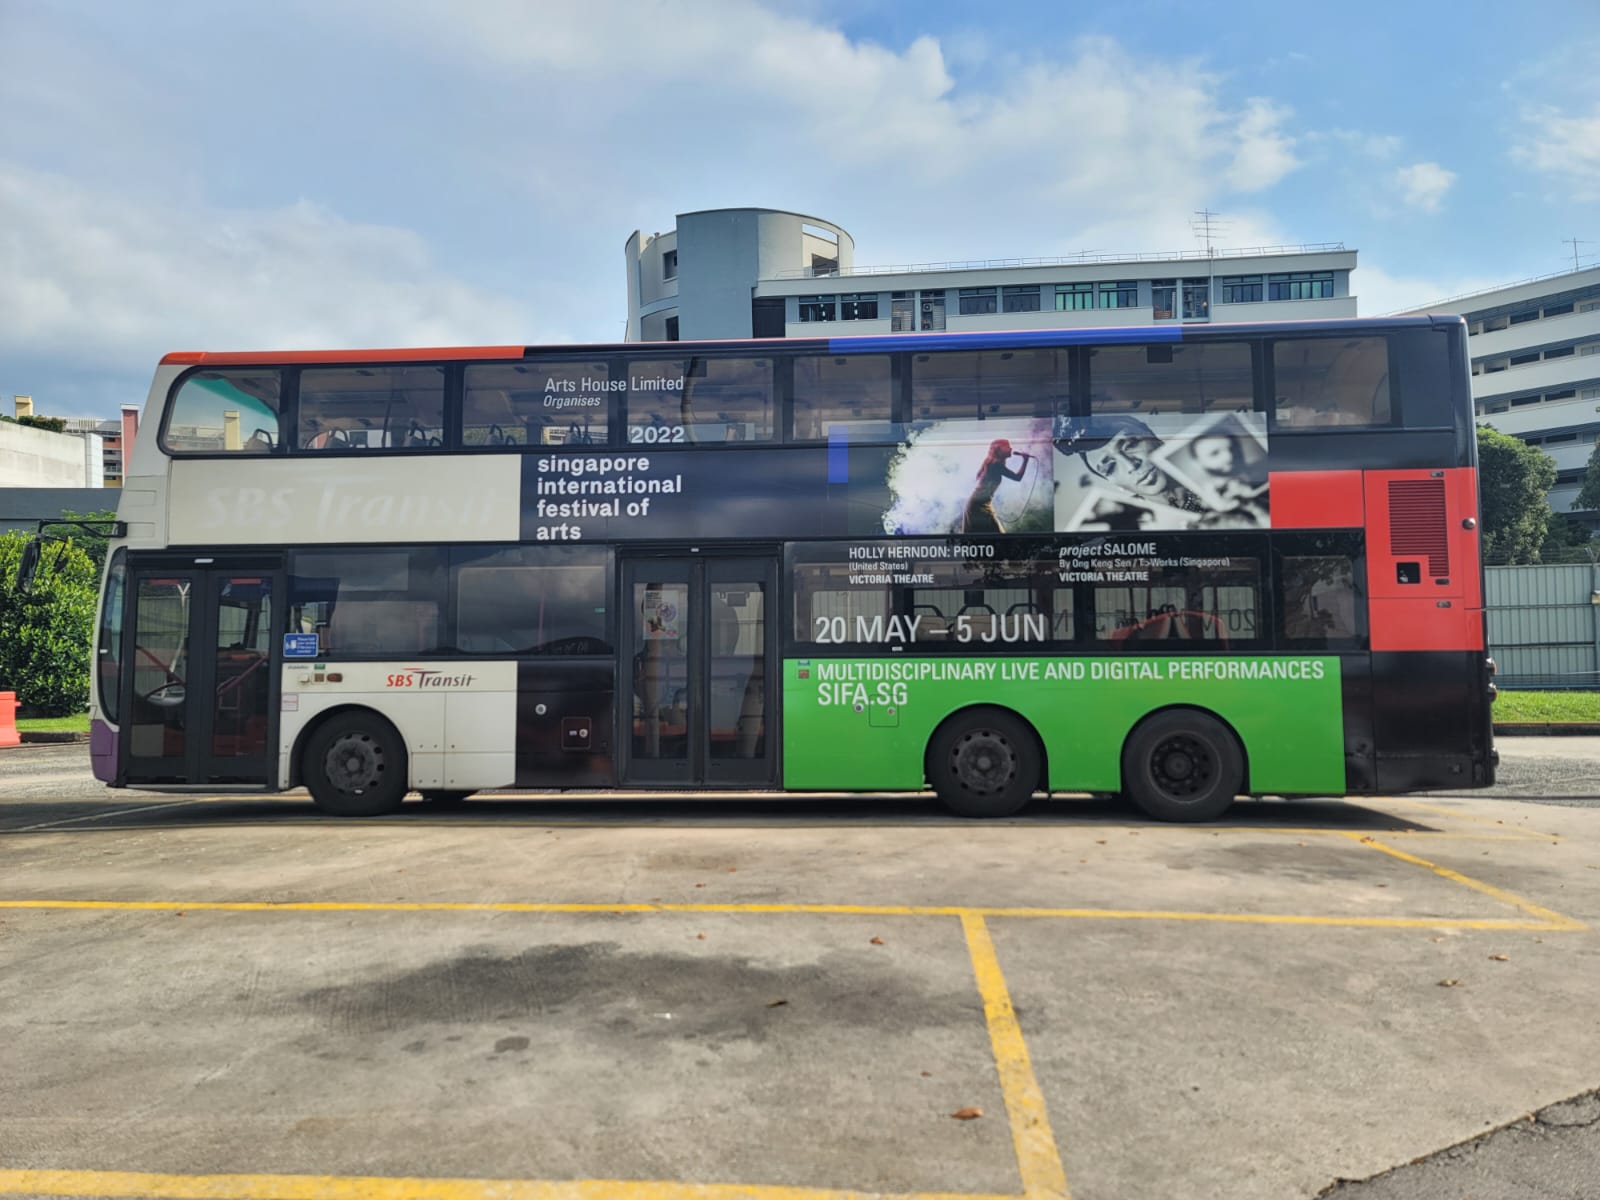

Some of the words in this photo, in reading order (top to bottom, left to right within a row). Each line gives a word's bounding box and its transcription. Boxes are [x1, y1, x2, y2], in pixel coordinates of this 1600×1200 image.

[544, 377, 576, 393] Arts
[581, 376, 627, 392] House
[631, 375, 684, 391] Limited
[543, 394, 601, 409] Organises
[630, 426, 685, 443] 2022
[536, 456, 650, 476] singapore
[536, 475, 682, 495] international
[536, 498, 620, 518] festival
[626, 497, 650, 517] of
[536, 522, 582, 541] arts
[849, 547, 884, 559] HOLLY
[887, 545, 951, 558] HERNDON:
[953, 544, 995, 558] PROTO
[1058, 545, 1102, 558] project
[1103, 542, 1157, 556] SALOME
[849, 562, 878, 571] (United
[879, 561, 909, 570] States)
[1059, 559, 1071, 569] By
[1072, 558, 1090, 568] Ong
[1090, 558, 1114, 569] Keng
[1114, 557, 1132, 568] Sen
[1179, 556, 1231, 568] (Singapore)
[849, 575, 892, 585] VICTORIA
[893, 574, 935, 584] THEATRE
[1059, 572, 1104, 582] VICTORIA
[1105, 571, 1149, 582] THEATRE
[815, 616, 847, 644] 20
[855, 614, 922, 643] MAY
[956, 615, 973, 643] 5
[980, 613, 1046, 643] JUN
[386, 674, 413, 687] SBS
[412, 670, 478, 689] Transit
[817, 662, 997, 681] MULTIDISCIPLINARY
[1001, 662, 1040, 680] LIVE
[1044, 662, 1086, 680] AND
[1090, 661, 1163, 680] DIGITAL
[1168, 660, 1325, 680] PERFORMANCES
[817, 682, 908, 706] SIFA.SG
